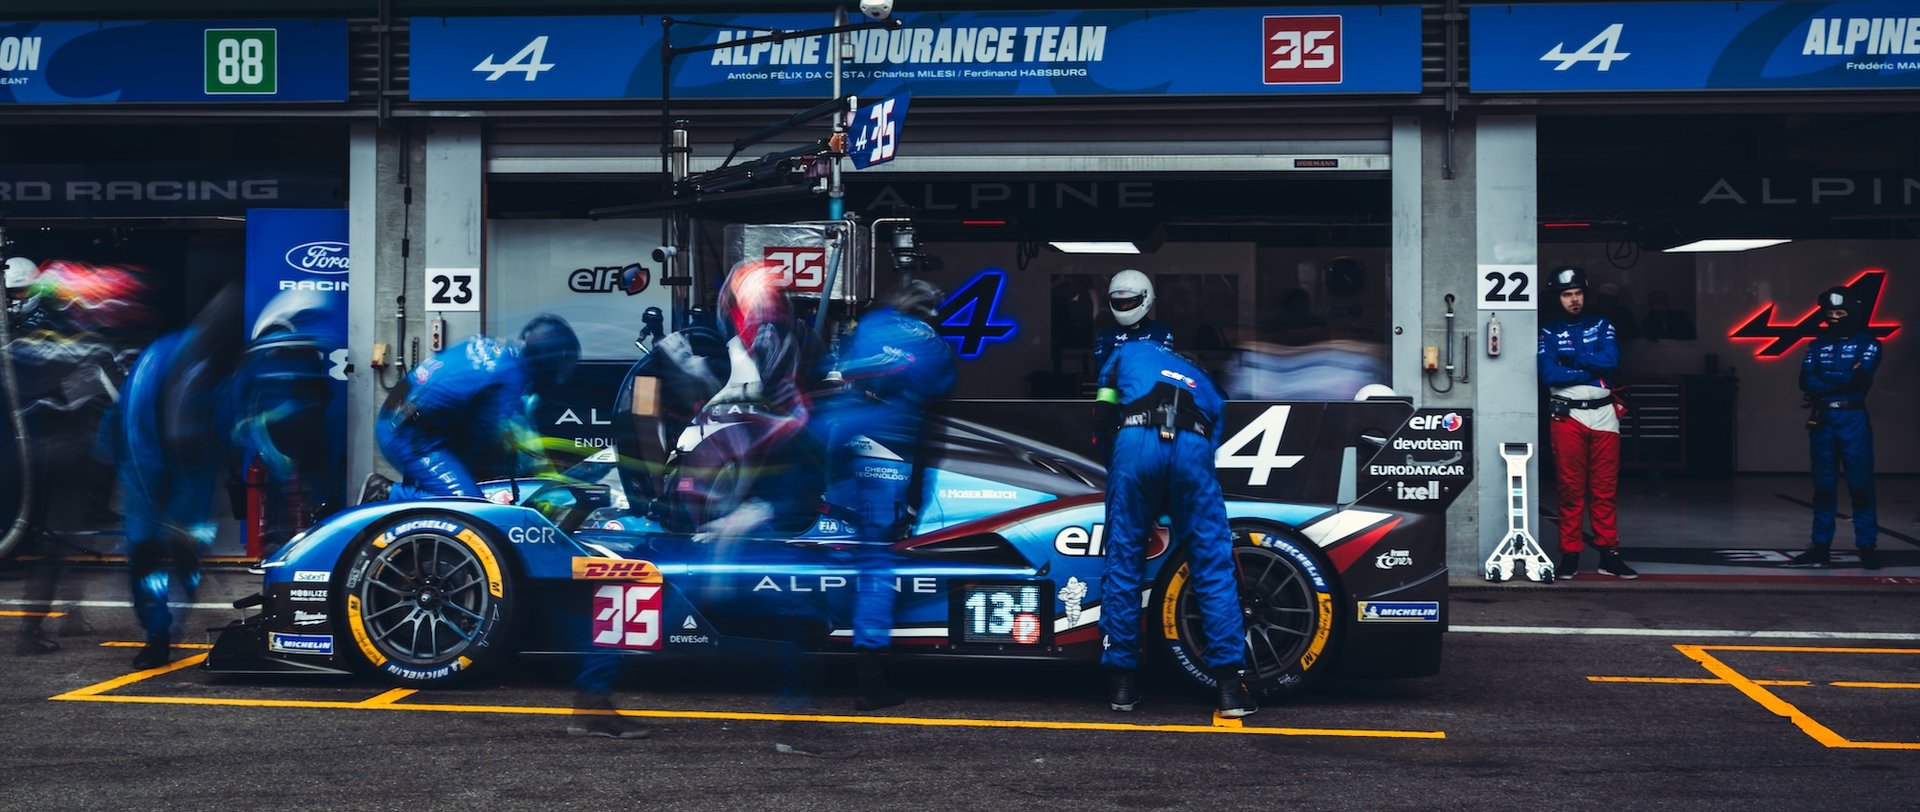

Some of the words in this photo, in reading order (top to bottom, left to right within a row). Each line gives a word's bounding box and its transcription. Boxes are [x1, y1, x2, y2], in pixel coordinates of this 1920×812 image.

[711, 29, 824, 65] ALPINE
[1023, 26, 1107, 62] TEAM
[1802, 18, 1920, 55] ALPINE
[1270, 30, 1335, 69] 35
[218, 38, 263, 84] 88
[1846, 61, 1894, 70] Frédéric
[1897, 62, 1920, 70] MA
[771, 70, 802, 79] FÉLIX
[805, 71, 822, 79] DA
[824, 71, 866, 79] CSTA
[874, 70, 914, 78] Charles
[918, 70, 955, 78] MILESI
[964, 69, 1018, 77] Ferdinand
[1020, 69, 1087, 77] HABSBURG
[870, 99, 895, 163] 35
[66, 180, 279, 201] RACING
[866, 182, 1154, 209] ALPINE
[765, 251, 824, 287] 35
[432, 275, 473, 304] 23
[571, 267, 622, 292] elf
[1485, 271, 1530, 301] 22
[1408, 415, 1444, 431] elf
[1393, 437, 1463, 451] devoteam
[864, 466, 899, 475] CHEOPS
[1370, 465, 1465, 476] EURODATACAR
[1397, 481, 1440, 500] ixell
[395, 520, 457, 536] MICHELIN
[508, 526, 556, 544] GCR
[1056, 525, 1106, 556] el
[585, 563, 650, 577] DHL
[1274, 540, 1325, 587] MICHELIN
[594, 585, 662, 647] 35
[1380, 608, 1437, 616] MICHELIN
[283, 640, 331, 649] MICHELIN
[669, 635, 709, 644] DEWESoft
[388, 664, 448, 680] MICHELIN
